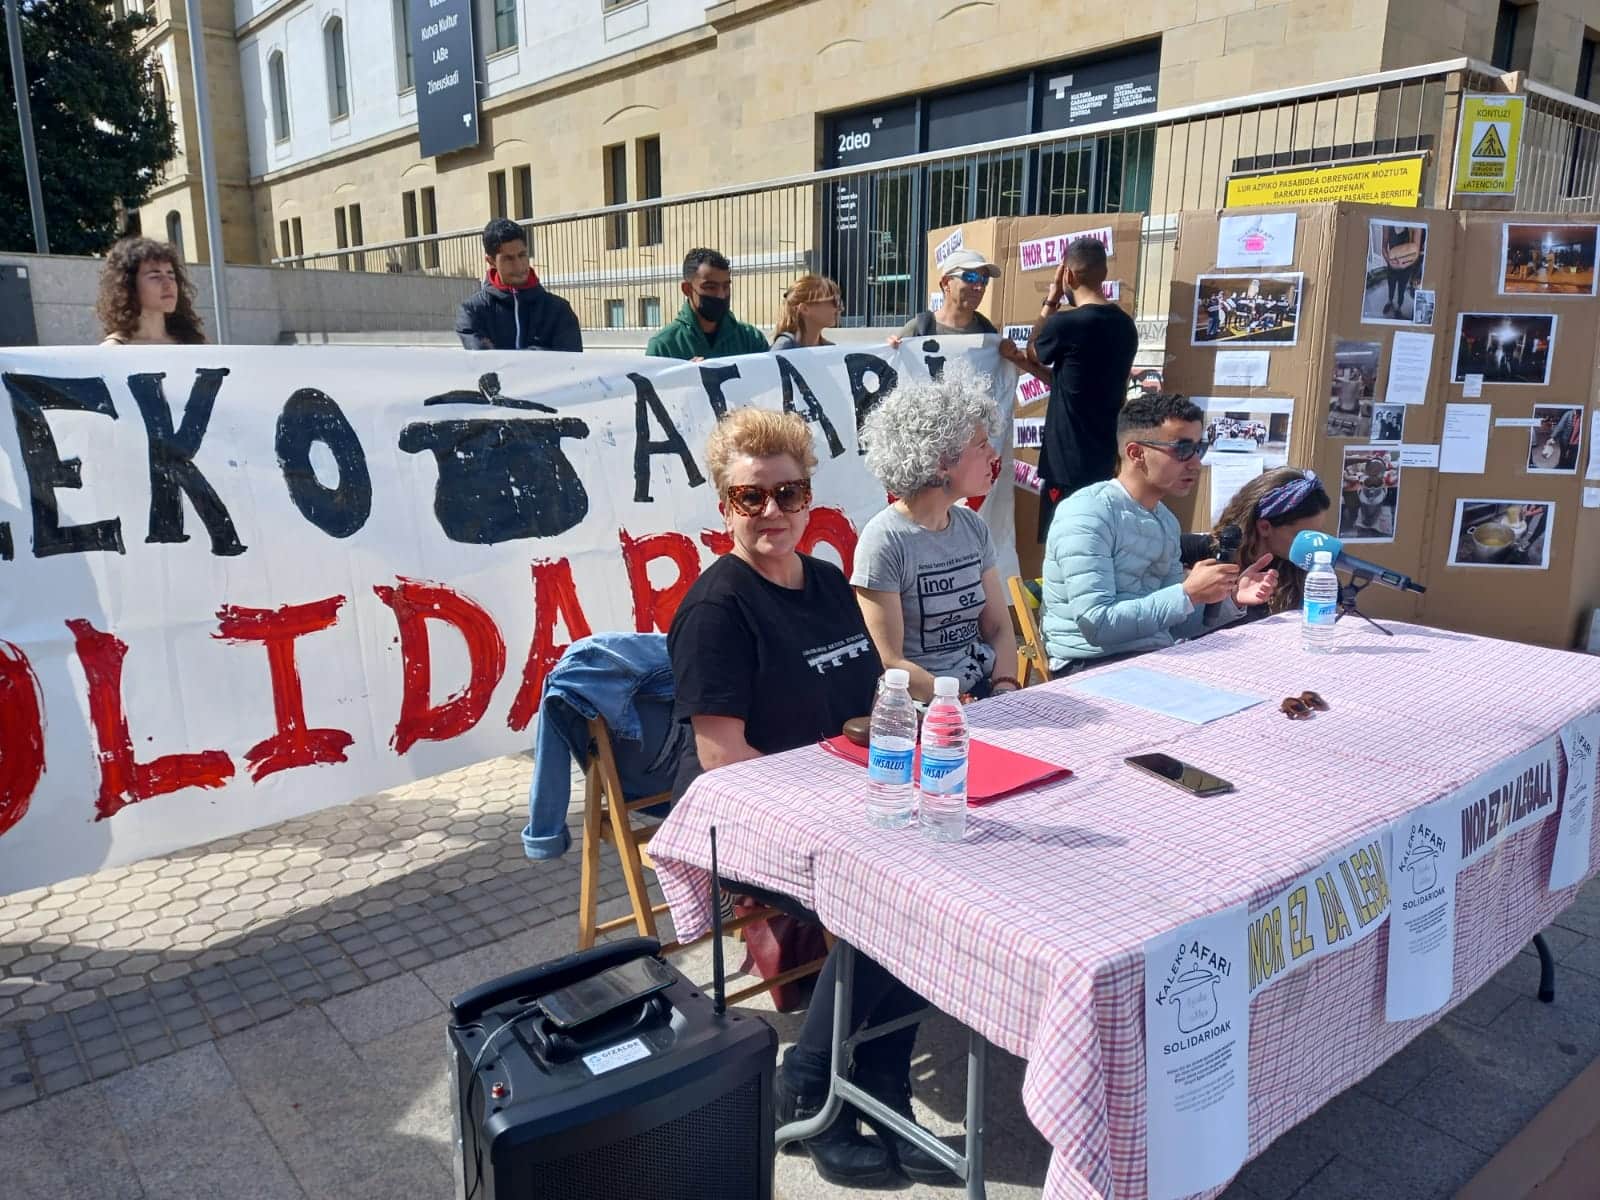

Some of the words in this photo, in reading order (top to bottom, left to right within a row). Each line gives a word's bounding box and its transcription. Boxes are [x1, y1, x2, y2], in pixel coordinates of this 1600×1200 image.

[432, 47, 449, 65] LABe
[837, 131, 871, 152] 2deo
[1237, 182, 1252, 193] LUR
[1252, 178, 1278, 191] AZPIKO
[1279, 173, 1320, 189] PASABIDEA
[1321, 171, 1370, 185] OBRENGATIK
[1371, 167, 1409, 180] MOZTUTA
[1308, 182, 1367, 197] ERAGOZPENAK
[1022, 243, 1042, 267] INOR
[1045, 240, 1057, 263] EZ
[1020, 378, 1044, 401] INOR
[1017, 426, 1038, 444] INOR
[0, 366, 373, 561] EKO
[923, 577, 955, 593] inor
[959, 592, 977, 606] ez
[872, 758, 905, 770] INSALUS
[1461, 798, 1486, 860] INOR
[1486, 789, 1501, 842] EZ
[1512, 759, 1552, 823] ILEGALA
[1418, 823, 1446, 853] AFARI
[1248, 906, 1286, 994] INOR
[1288, 886, 1315, 960] EZ
[1315, 872, 1353, 945] DA
[1155, 943, 1186, 1006] KALEKO
[1190, 940, 1232, 977] AFARI
[1163, 1020, 1232, 1055] SOLIDARIOAK
